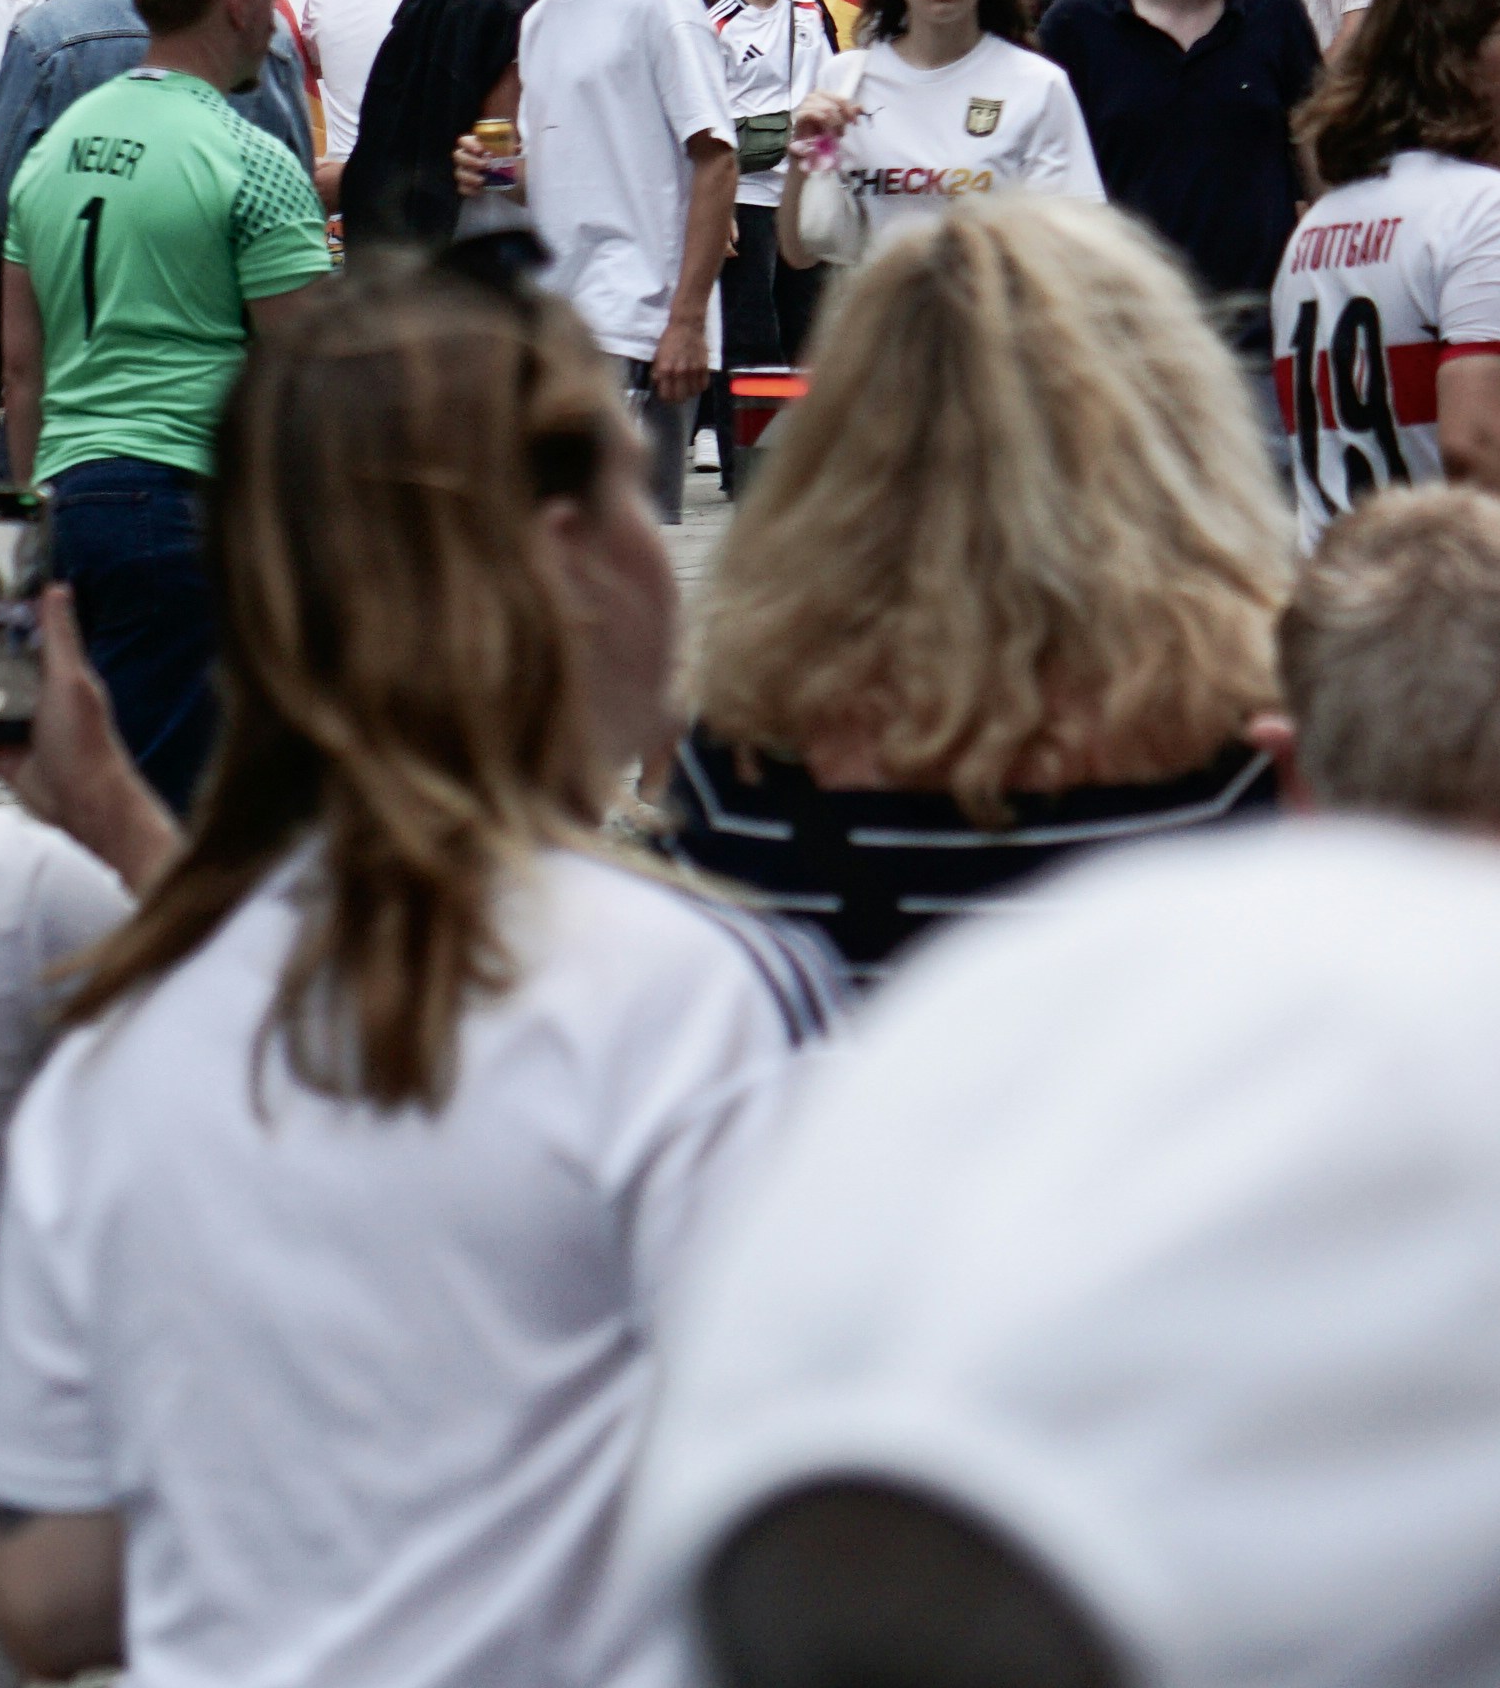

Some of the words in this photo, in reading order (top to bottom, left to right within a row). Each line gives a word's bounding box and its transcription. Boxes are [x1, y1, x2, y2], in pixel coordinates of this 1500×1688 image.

[66, 135, 147, 181] NEUER
[76, 196, 106, 345] 1
[1291, 216, 1405, 275] STUTTGART
